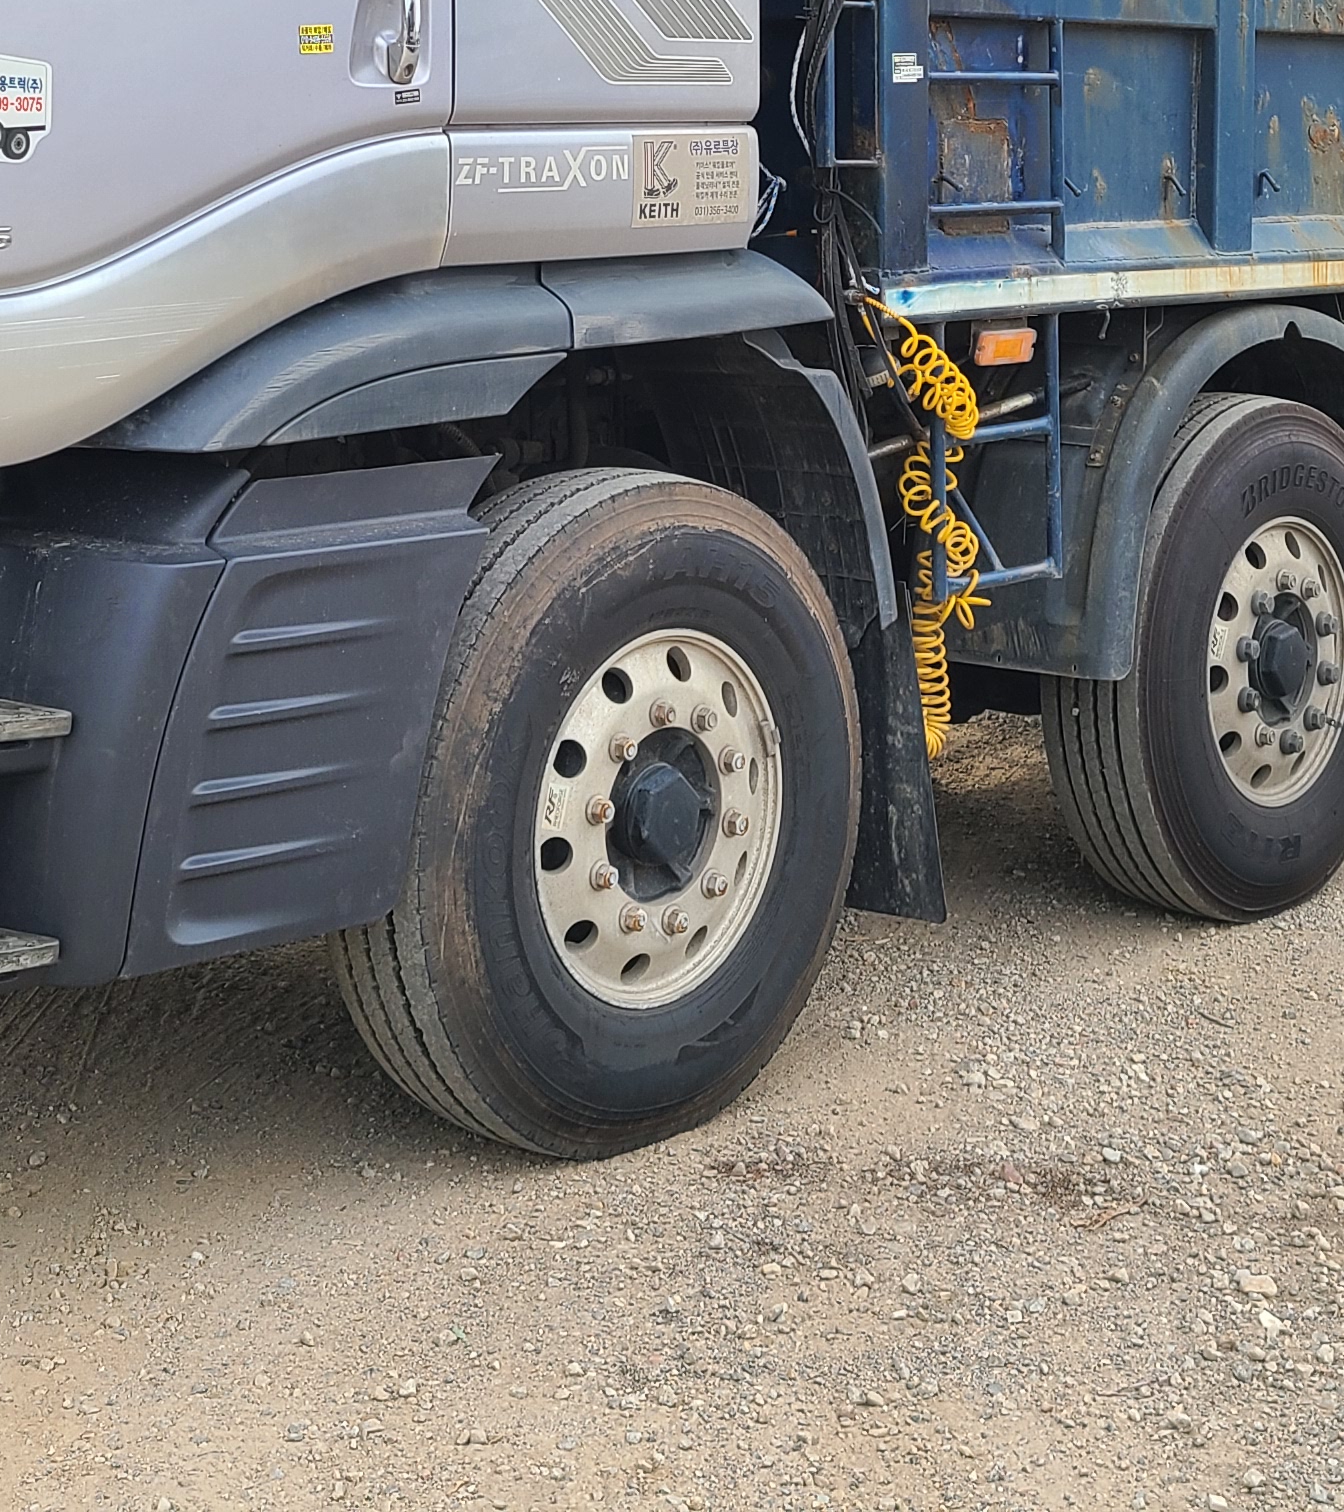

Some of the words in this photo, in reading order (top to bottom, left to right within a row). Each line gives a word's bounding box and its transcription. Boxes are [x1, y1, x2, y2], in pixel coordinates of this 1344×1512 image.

[689, 138, 739, 156] (주)유로특장
[455, 148, 629, 187] ZF-TRAXON
[638, 201, 680, 219] KEITH
